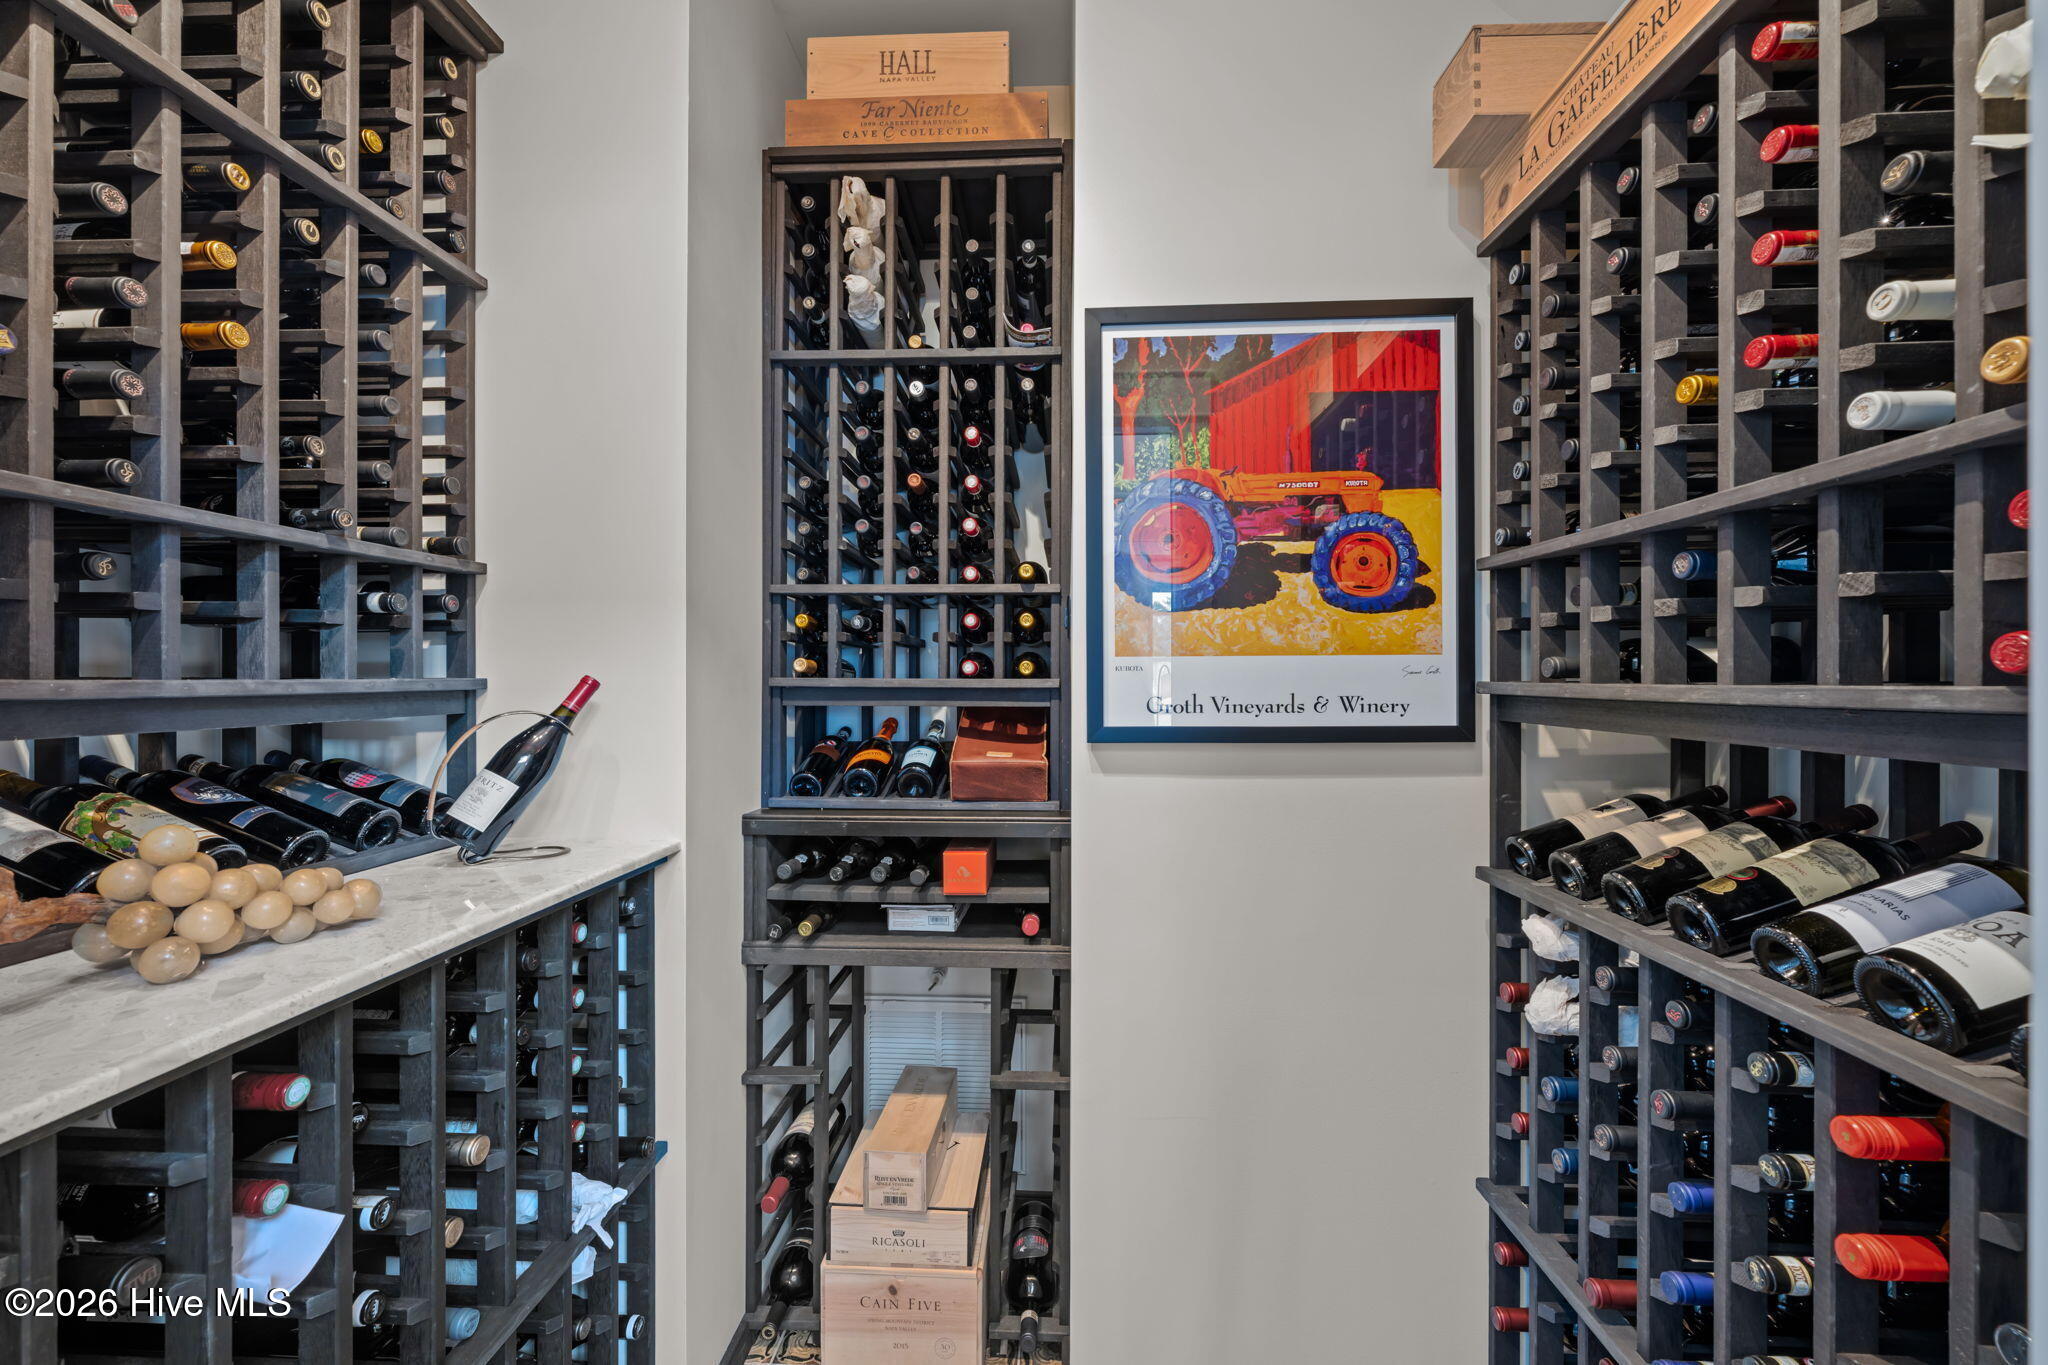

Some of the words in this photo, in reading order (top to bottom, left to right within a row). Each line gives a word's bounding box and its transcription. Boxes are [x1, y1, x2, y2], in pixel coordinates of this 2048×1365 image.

[879, 50, 936, 76] HALL
[1518, 145, 1540, 181] LA
[1548, 0, 1682, 148] GAFFELIÈRE
[861, 100, 896, 119] Far
[898, 98, 969, 119] Niente
[842, 130, 878, 139] CAVE
[899, 126, 989, 137] COLLECTION
[1146, 693, 1204, 716] Groth
[1210, 693, 1305, 718] Vineyards
[1313, 695, 1330, 715] &
[1338, 693, 1411, 718] Winery
[1859, 892, 1911, 921] CHARIAS
[1963, 918, 2031, 949] OA
[872, 1236, 926, 1248] RICASOLI
[860, 1296, 899, 1310] CAIN
[908, 1298, 942, 1312] FIVE
